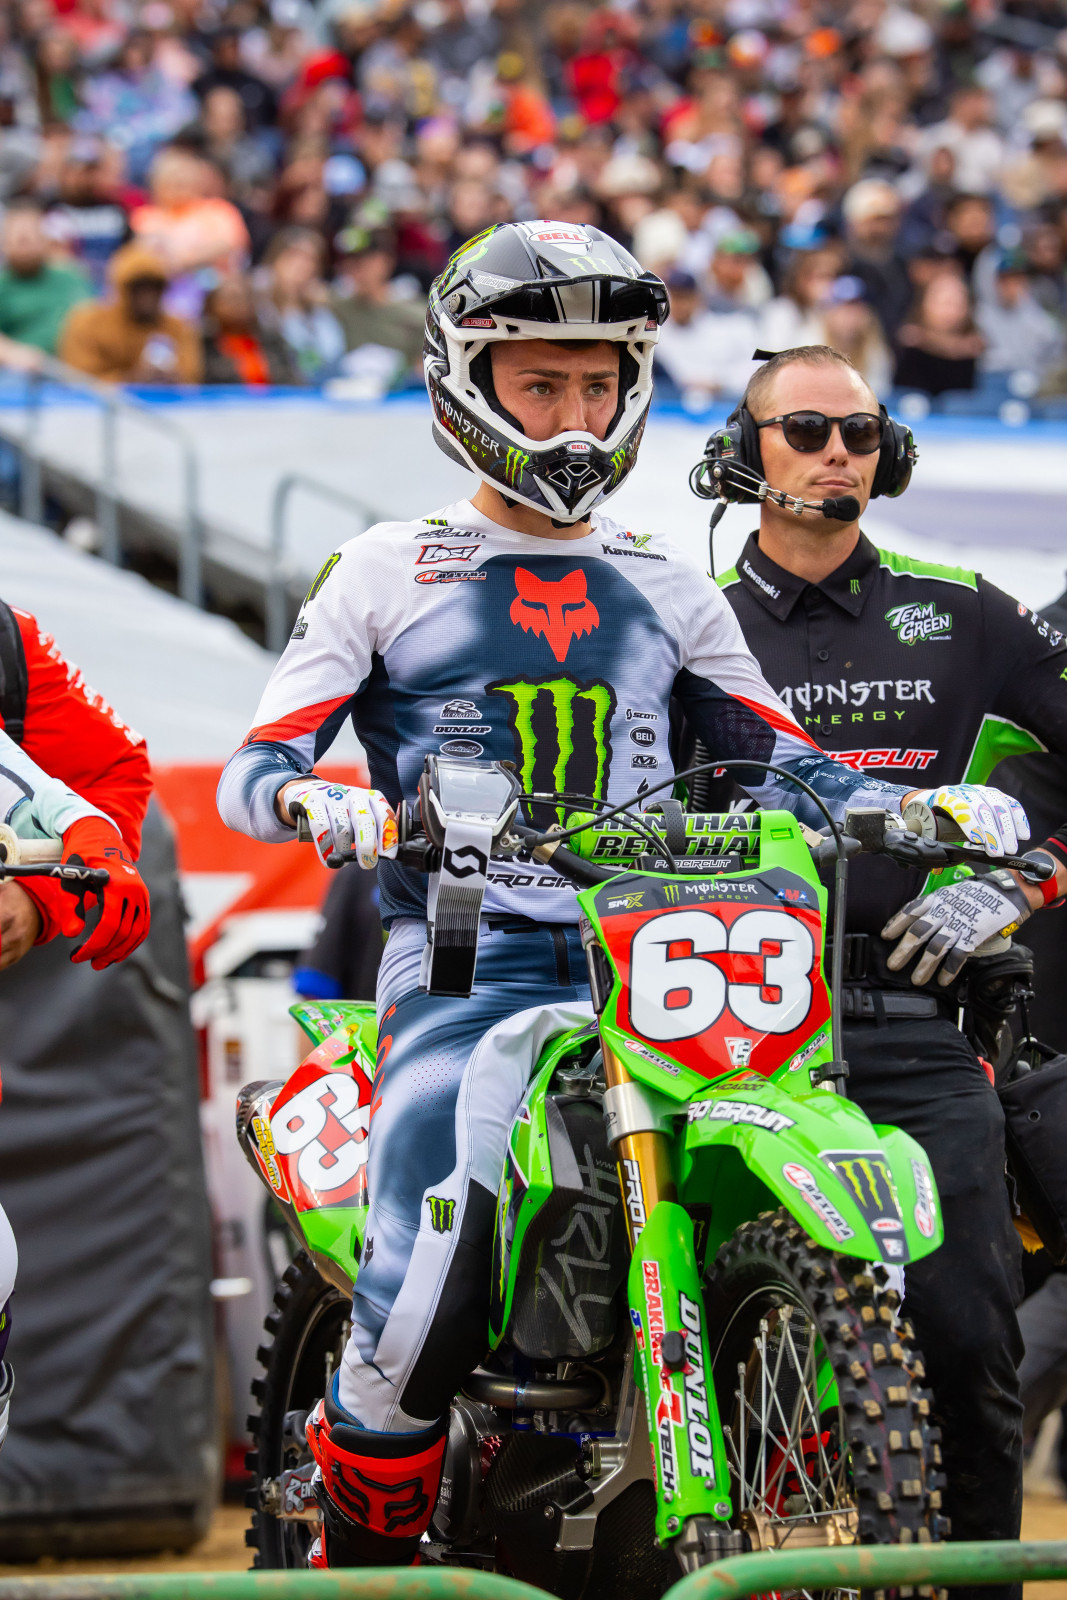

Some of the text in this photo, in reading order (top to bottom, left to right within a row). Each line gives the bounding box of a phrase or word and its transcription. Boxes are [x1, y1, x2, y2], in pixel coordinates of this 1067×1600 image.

[538, 233, 584, 241] BELL
[436, 391, 500, 457] MONSTER
[443, 416, 487, 458] ENERGY
[742, 560, 780, 600] Kawasaki
[887, 604, 933, 627] TEAM
[900, 615, 950, 640] GREEN
[805, 711, 905, 725] NERGY
[636, 732, 653, 741] BELL
[50, 867, 90, 879] ASV
[685, 882, 758, 895] MONSTER
[774, 888, 809, 903] AMA
[607, 894, 644, 909] SMX
[629, 908, 815, 1043] 63
[710, 1100, 797, 1134] CIRCUIT
[269, 1072, 370, 1192] 63
[252, 1117, 279, 1188] CIRCUIT
[802, 1182, 851, 1238] MAXIMA
